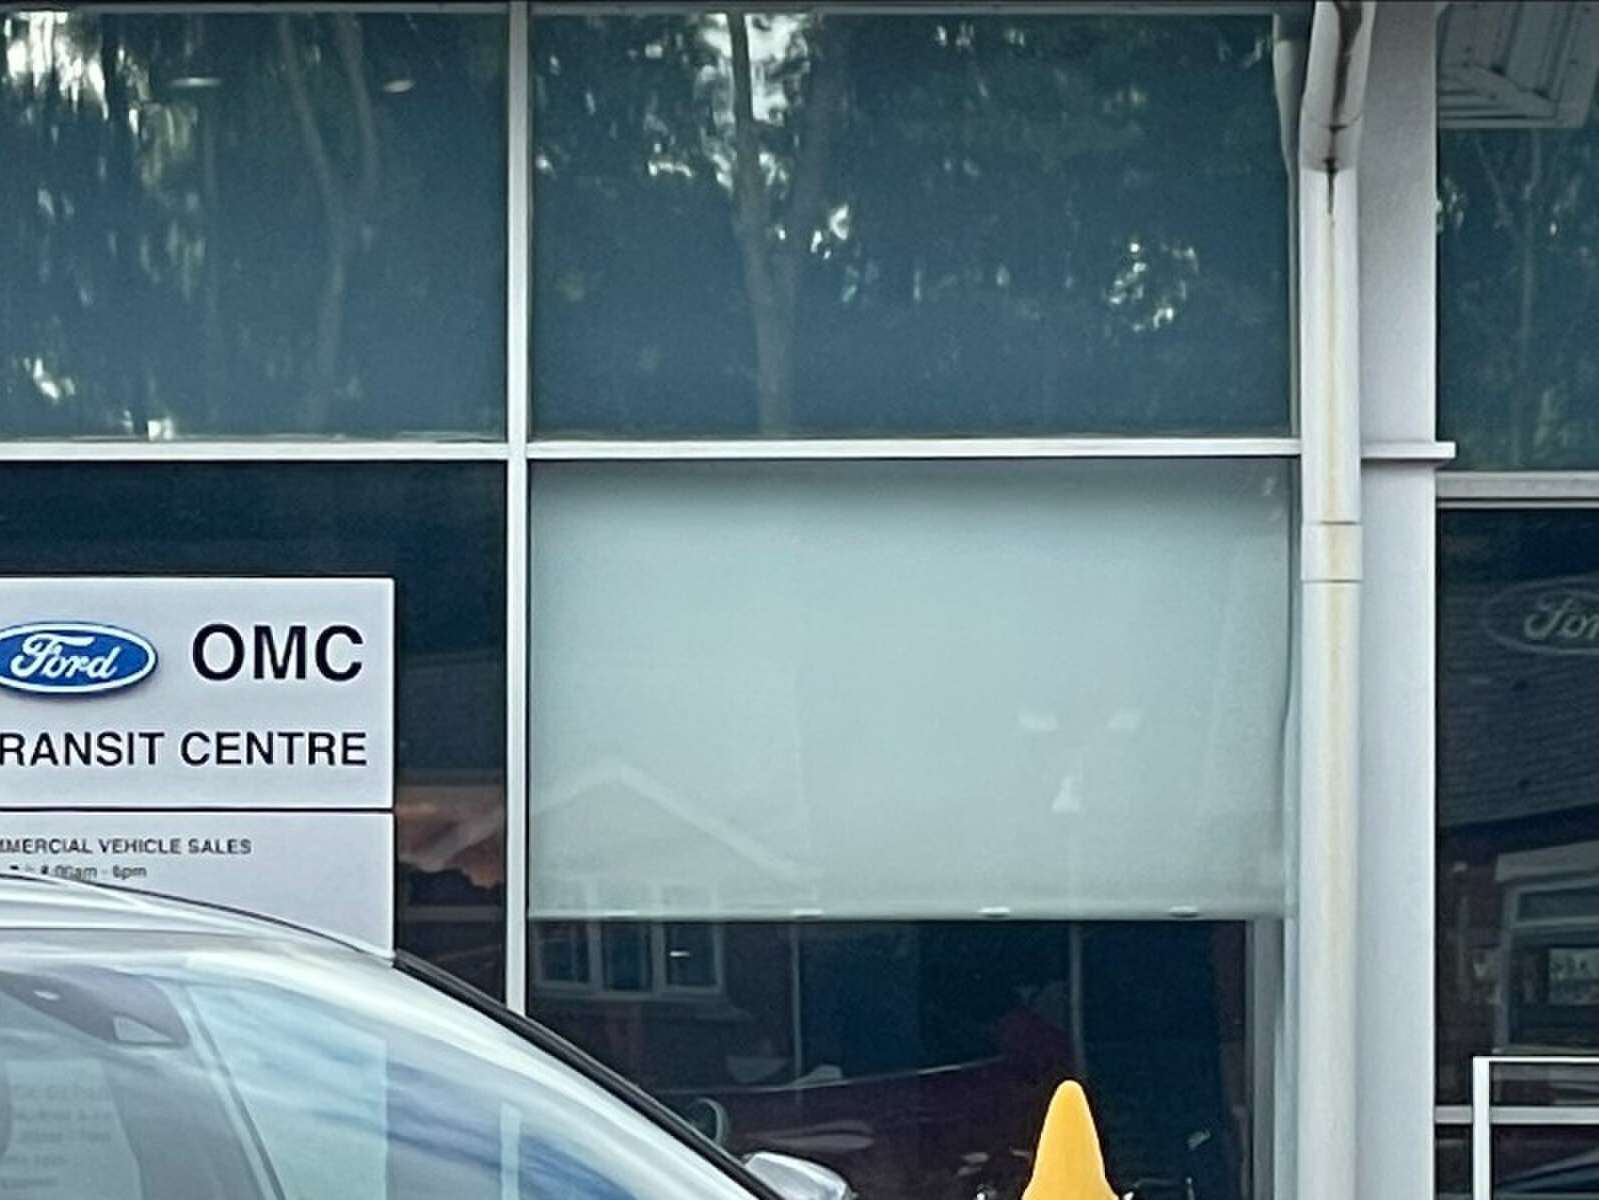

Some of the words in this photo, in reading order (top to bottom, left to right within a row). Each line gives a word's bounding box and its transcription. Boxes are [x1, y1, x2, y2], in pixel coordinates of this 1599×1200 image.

[9, 631, 123, 680] Ford
[192, 623, 363, 682] OMC
[180, 731, 367, 766] CENTRE
[98, 838, 182, 855] VEHICLE
[188, 838, 252, 855] SALES
